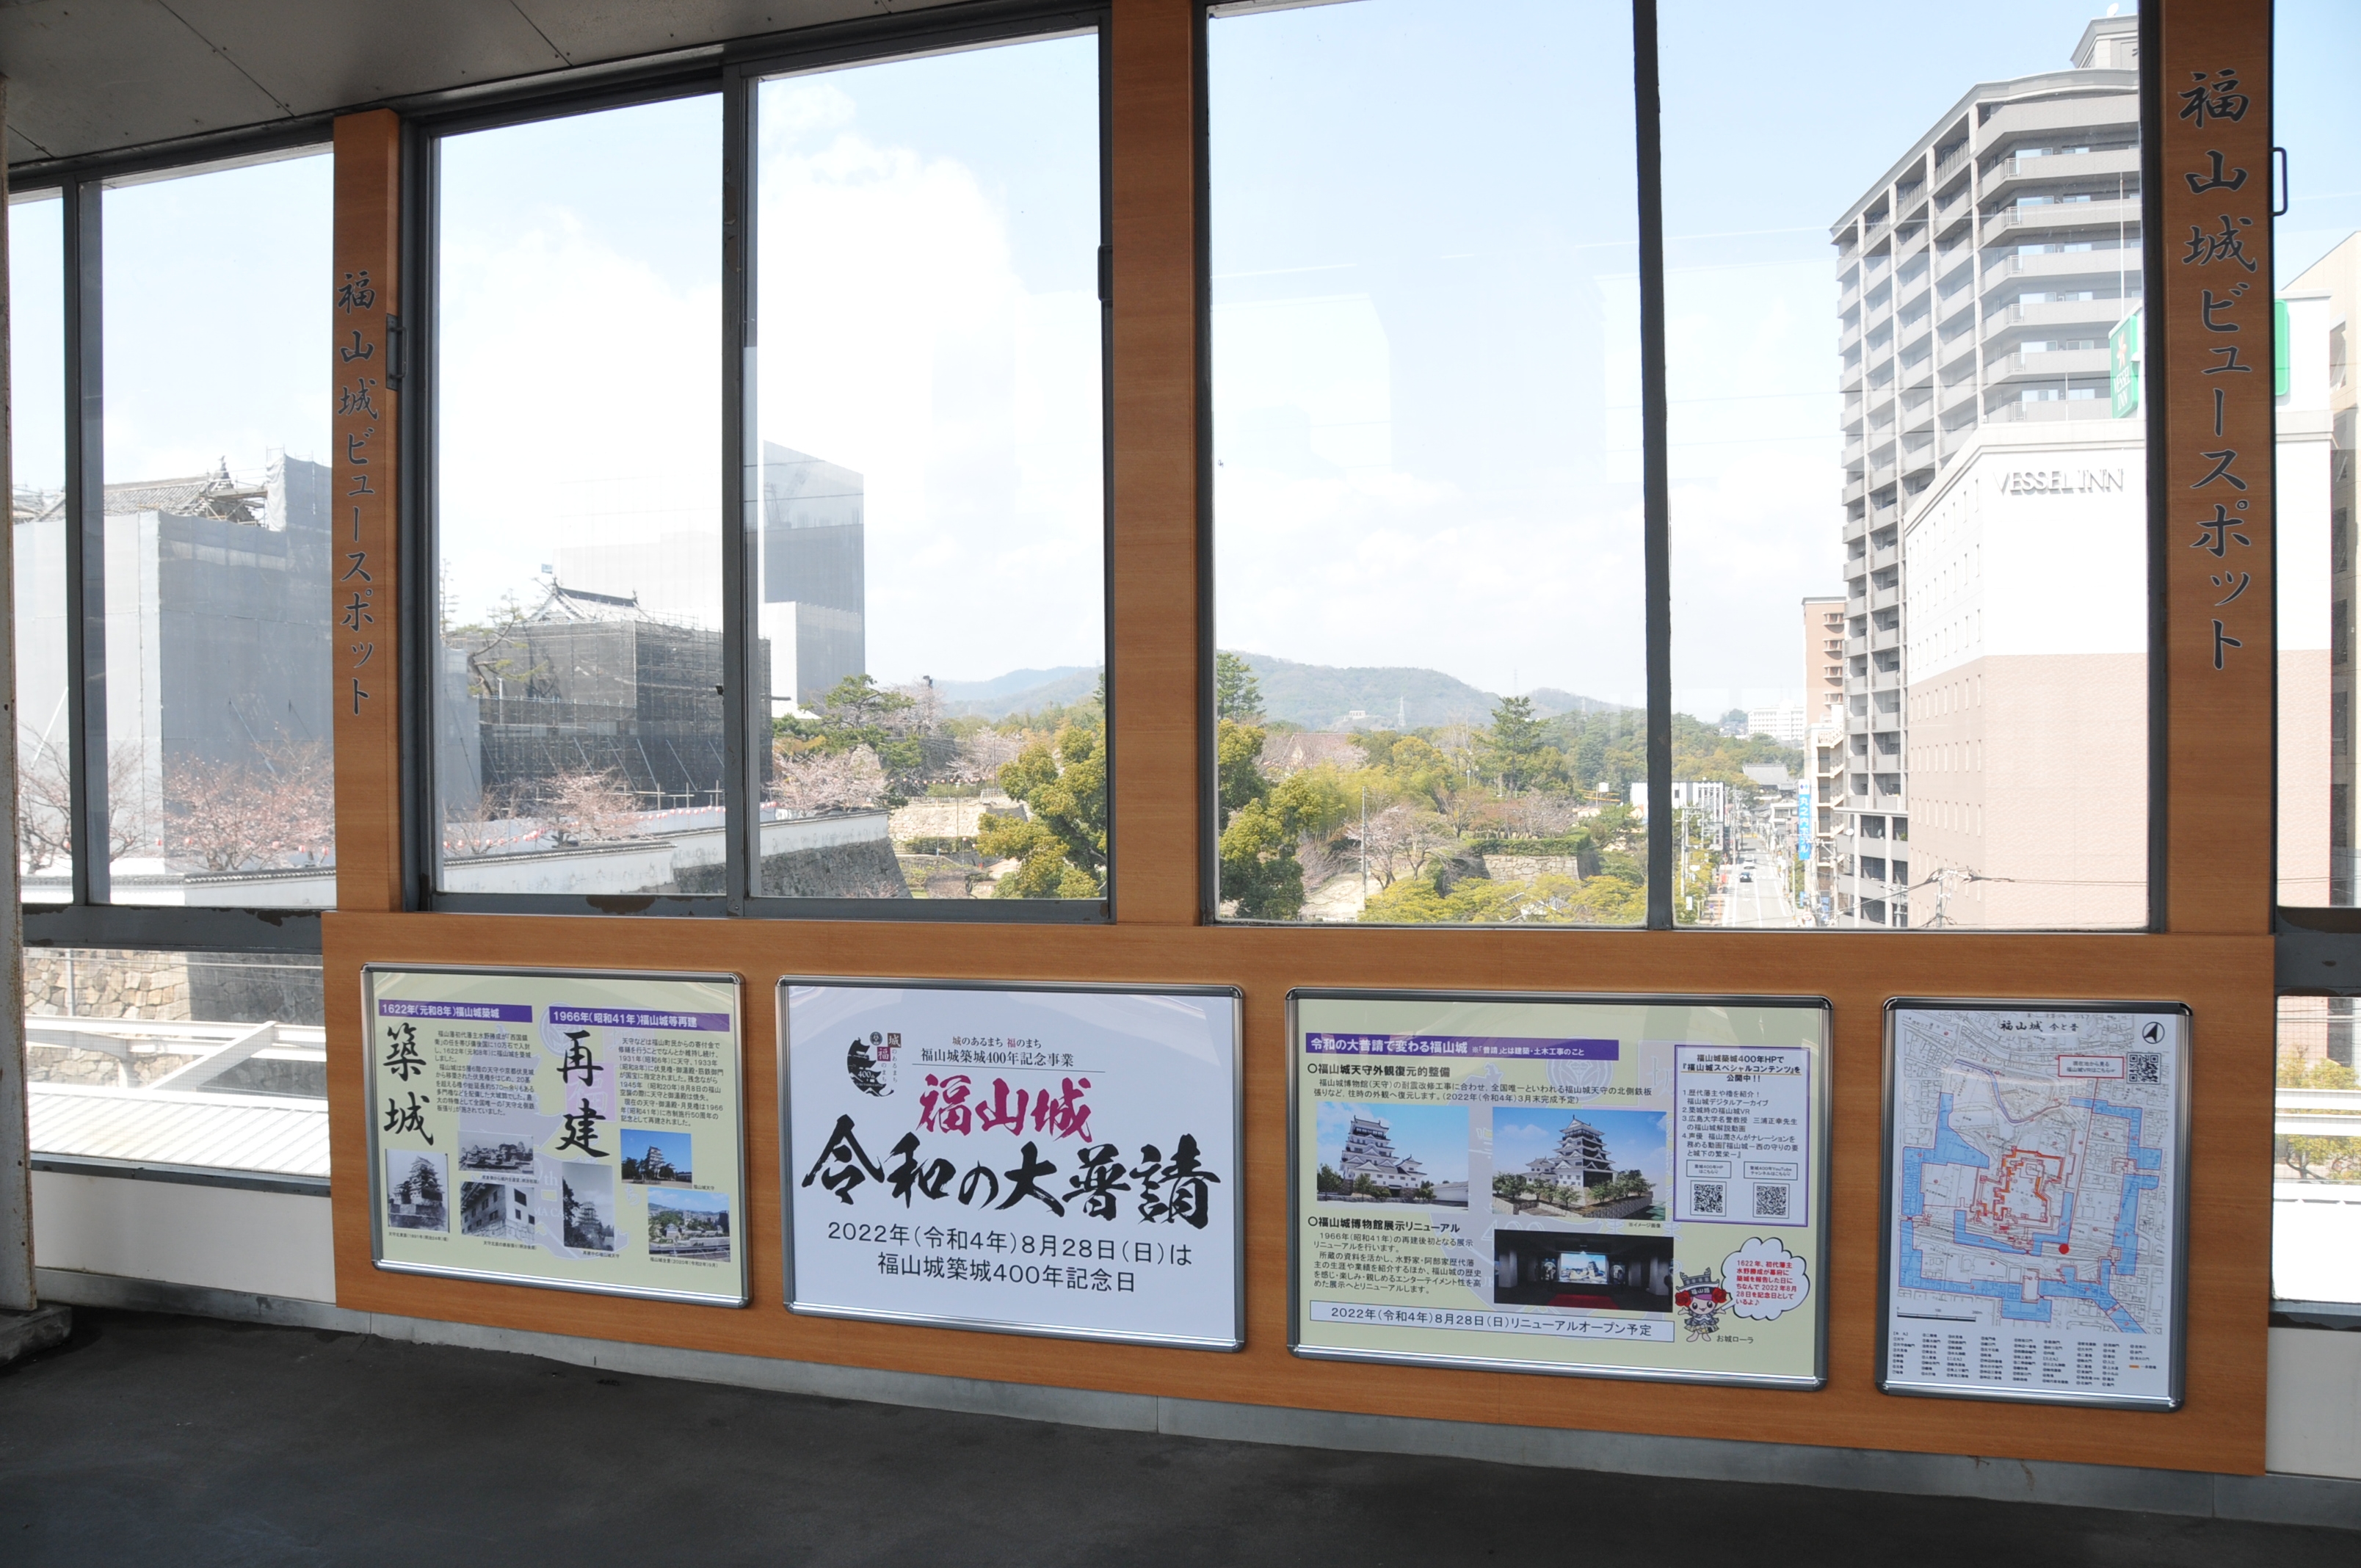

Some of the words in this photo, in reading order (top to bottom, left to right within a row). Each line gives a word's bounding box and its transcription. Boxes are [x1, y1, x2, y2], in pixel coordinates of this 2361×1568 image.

[2178, 68, 2257, 671] 福山城ビュースポット
[1992, 470, 2075, 496] VESSEL
[2077, 468, 2124, 493] INN
[336, 270, 379, 716] 福山城ビュースポット
[382, 1004, 499, 1019] 1622年（元和8年）福山城築城
[553, 1011, 697, 1028] 1966年（昭和41年）福山城等再建
[2000, 1020, 2043, 1032] 福山城
[2049, 1023, 2079, 1032] 今と昔
[622, 1037, 720, 1048] 天守などは福山町民からの寄付金で
[952, 1036, 1004, 1048] 城のあるまち
[1007, 1037, 1042, 1049] 福のまち
[1310, 1037, 1468, 1054] 令和の大普請で変わる福山城
[921, 1048, 1074, 1067] 福山城築城400年記念事業
[1697, 1054, 1784, 1063] 福山城築城400年HPで
[1683, 1063, 1801, 1074] 『福山城スペシャルコンテンツ』を
[382, 1022, 435, 1147] 築城
[556, 1029, 610, 1158] 再建
[915, 1073, 1093, 1143] 福山城
[1687, 1097, 1769, 1106] 福山城デジタルアーカイブ
[620, 1115, 691, 1127] 記念として再建されました。
[1753, 1117, 1798, 1125] 三浦正幸先生
[1687, 1124, 1746, 1133] の福山城解説動画
[1708, 1133, 1796, 1143] 福山潤さんがナレーションを
[801, 1114, 1222, 1230] 令和の大普請
[827, 1221, 1193, 1267] 2022年（令和4年）8月28日（日）は
[1313, 1241, 1399, 1253] リニューアルを行います。
[1319, 1251, 1474, 1267] 所蔵の資料を活かし、水野家・阿部家歴代藩
[877, 1252, 1136, 1293] 福山城築城400年記念日
[1313, 1260, 1481, 1277] 主の生涯や業績を紹介するほか、福山城の歴史
[1736, 1268, 1789, 1276] 水野勝成が幕府に
[1313, 1270, 1481, 1288] を感じ・楽しみ・親しめるエンターテイメント性を高
[1736, 1275, 1793, 1284] 築城を報告した日に
[1313, 1280, 1430, 1294] めた展示へとリニューアルします。
[1736, 1291, 1794, 1300] 28日を記念日として
[1716, 1335, 1754, 1344] お城ローラ
